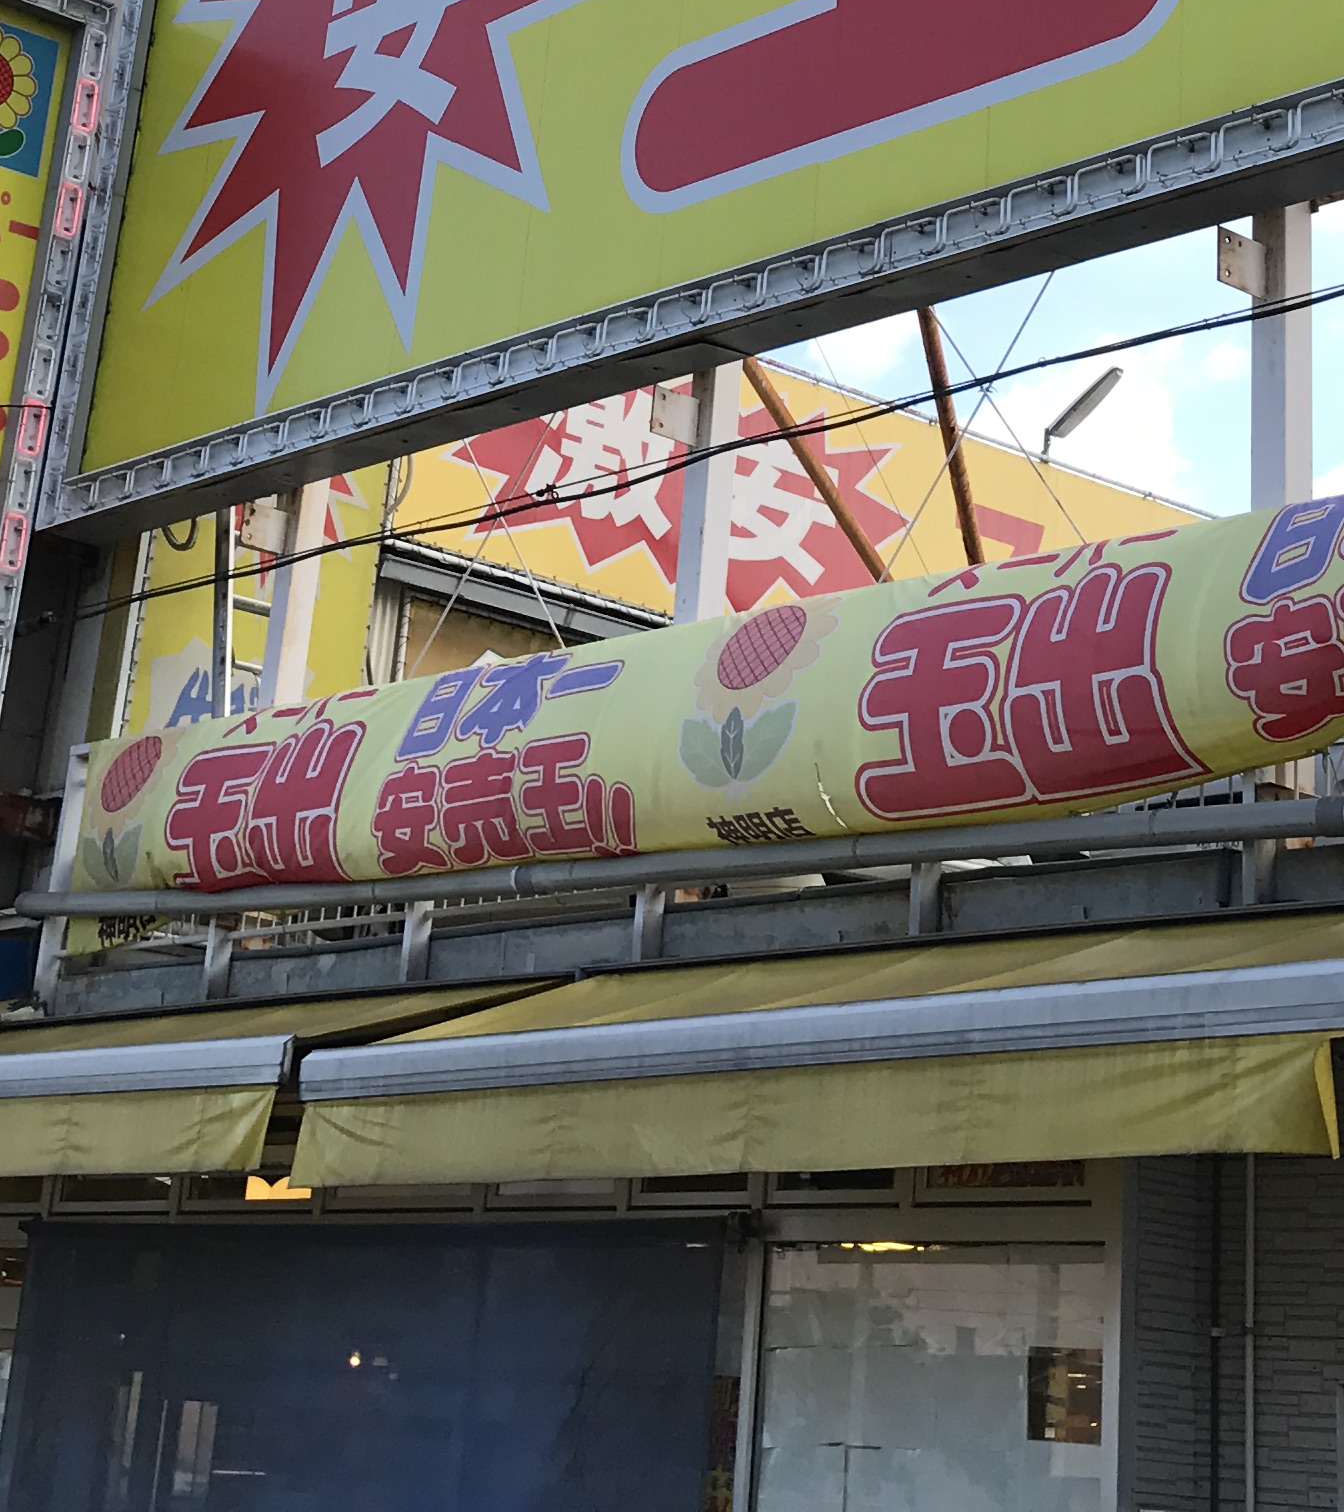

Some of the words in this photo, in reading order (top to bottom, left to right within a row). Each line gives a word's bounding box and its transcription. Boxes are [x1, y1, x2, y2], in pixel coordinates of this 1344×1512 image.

[394, 651, 625, 763] 日本一
[855, 561, 1208, 822] 玉出
[165, 718, 368, 892] 玉出
[706, 805, 816, 845] 神明店
